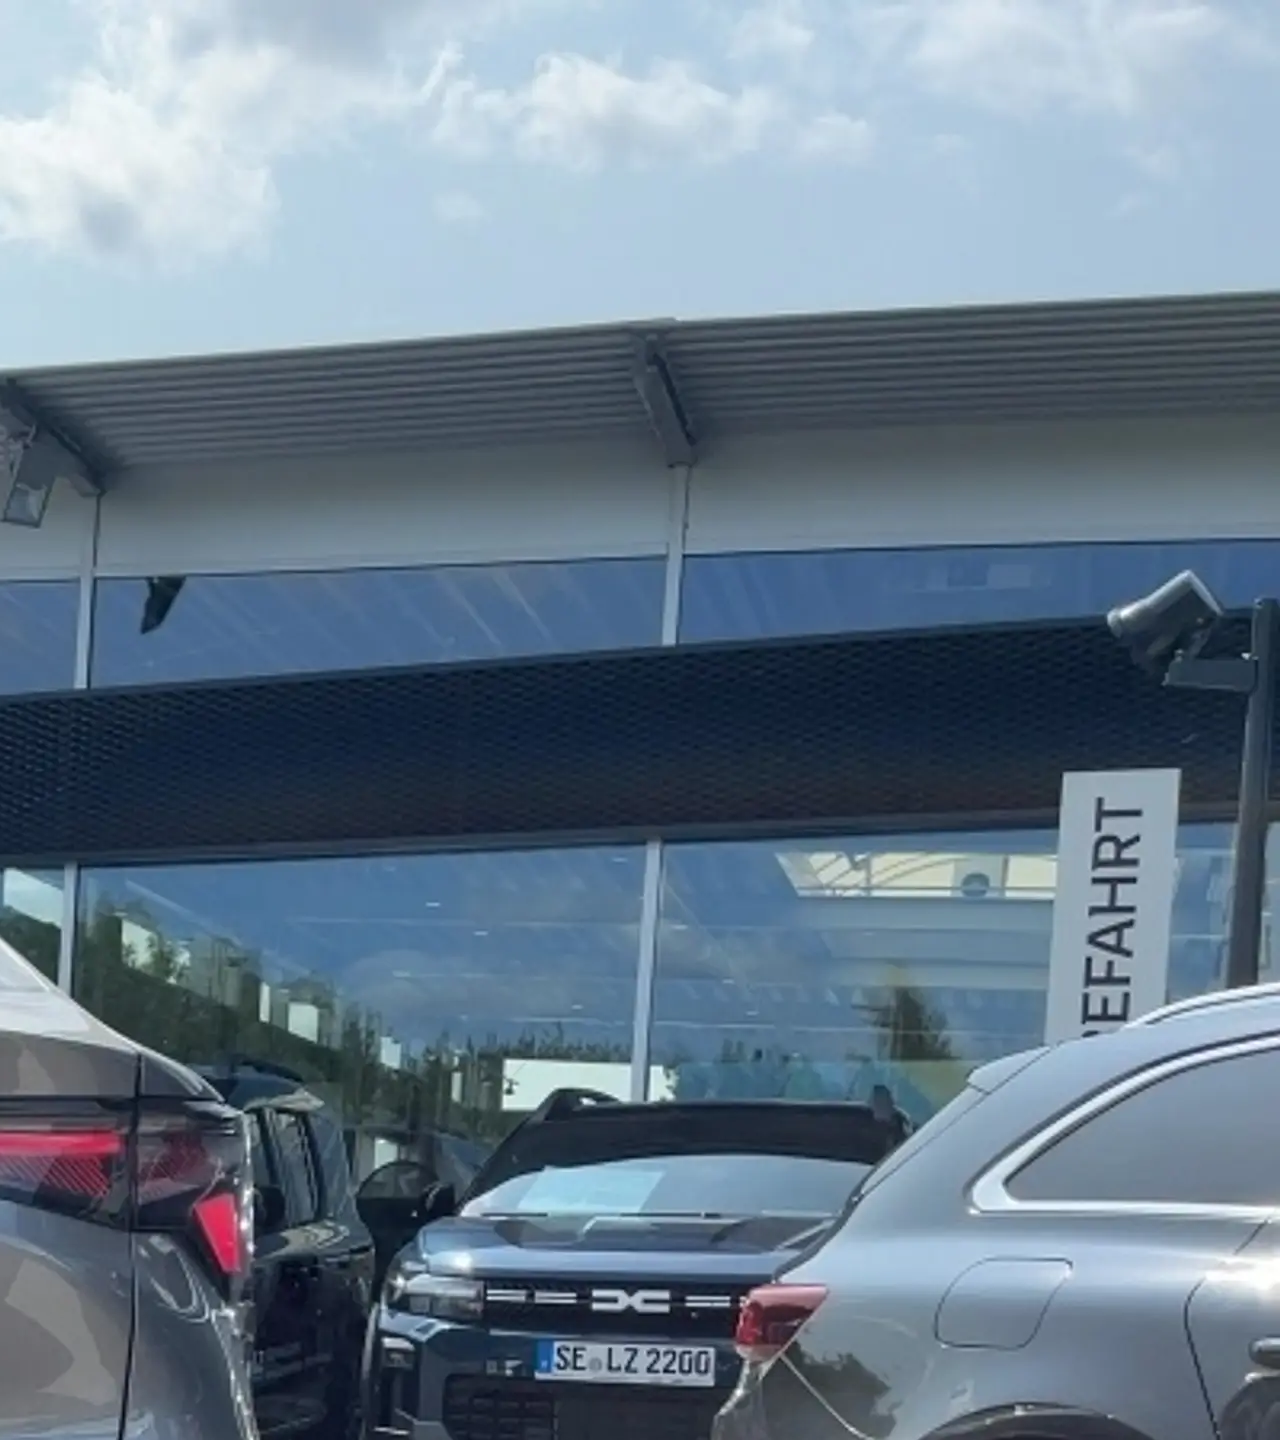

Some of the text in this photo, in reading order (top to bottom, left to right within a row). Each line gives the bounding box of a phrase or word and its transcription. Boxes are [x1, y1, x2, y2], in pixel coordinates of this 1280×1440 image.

[1081, 796, 1143, 1038] EFAHRT
[556, 1345, 712, 1375] SE LZ 2200
